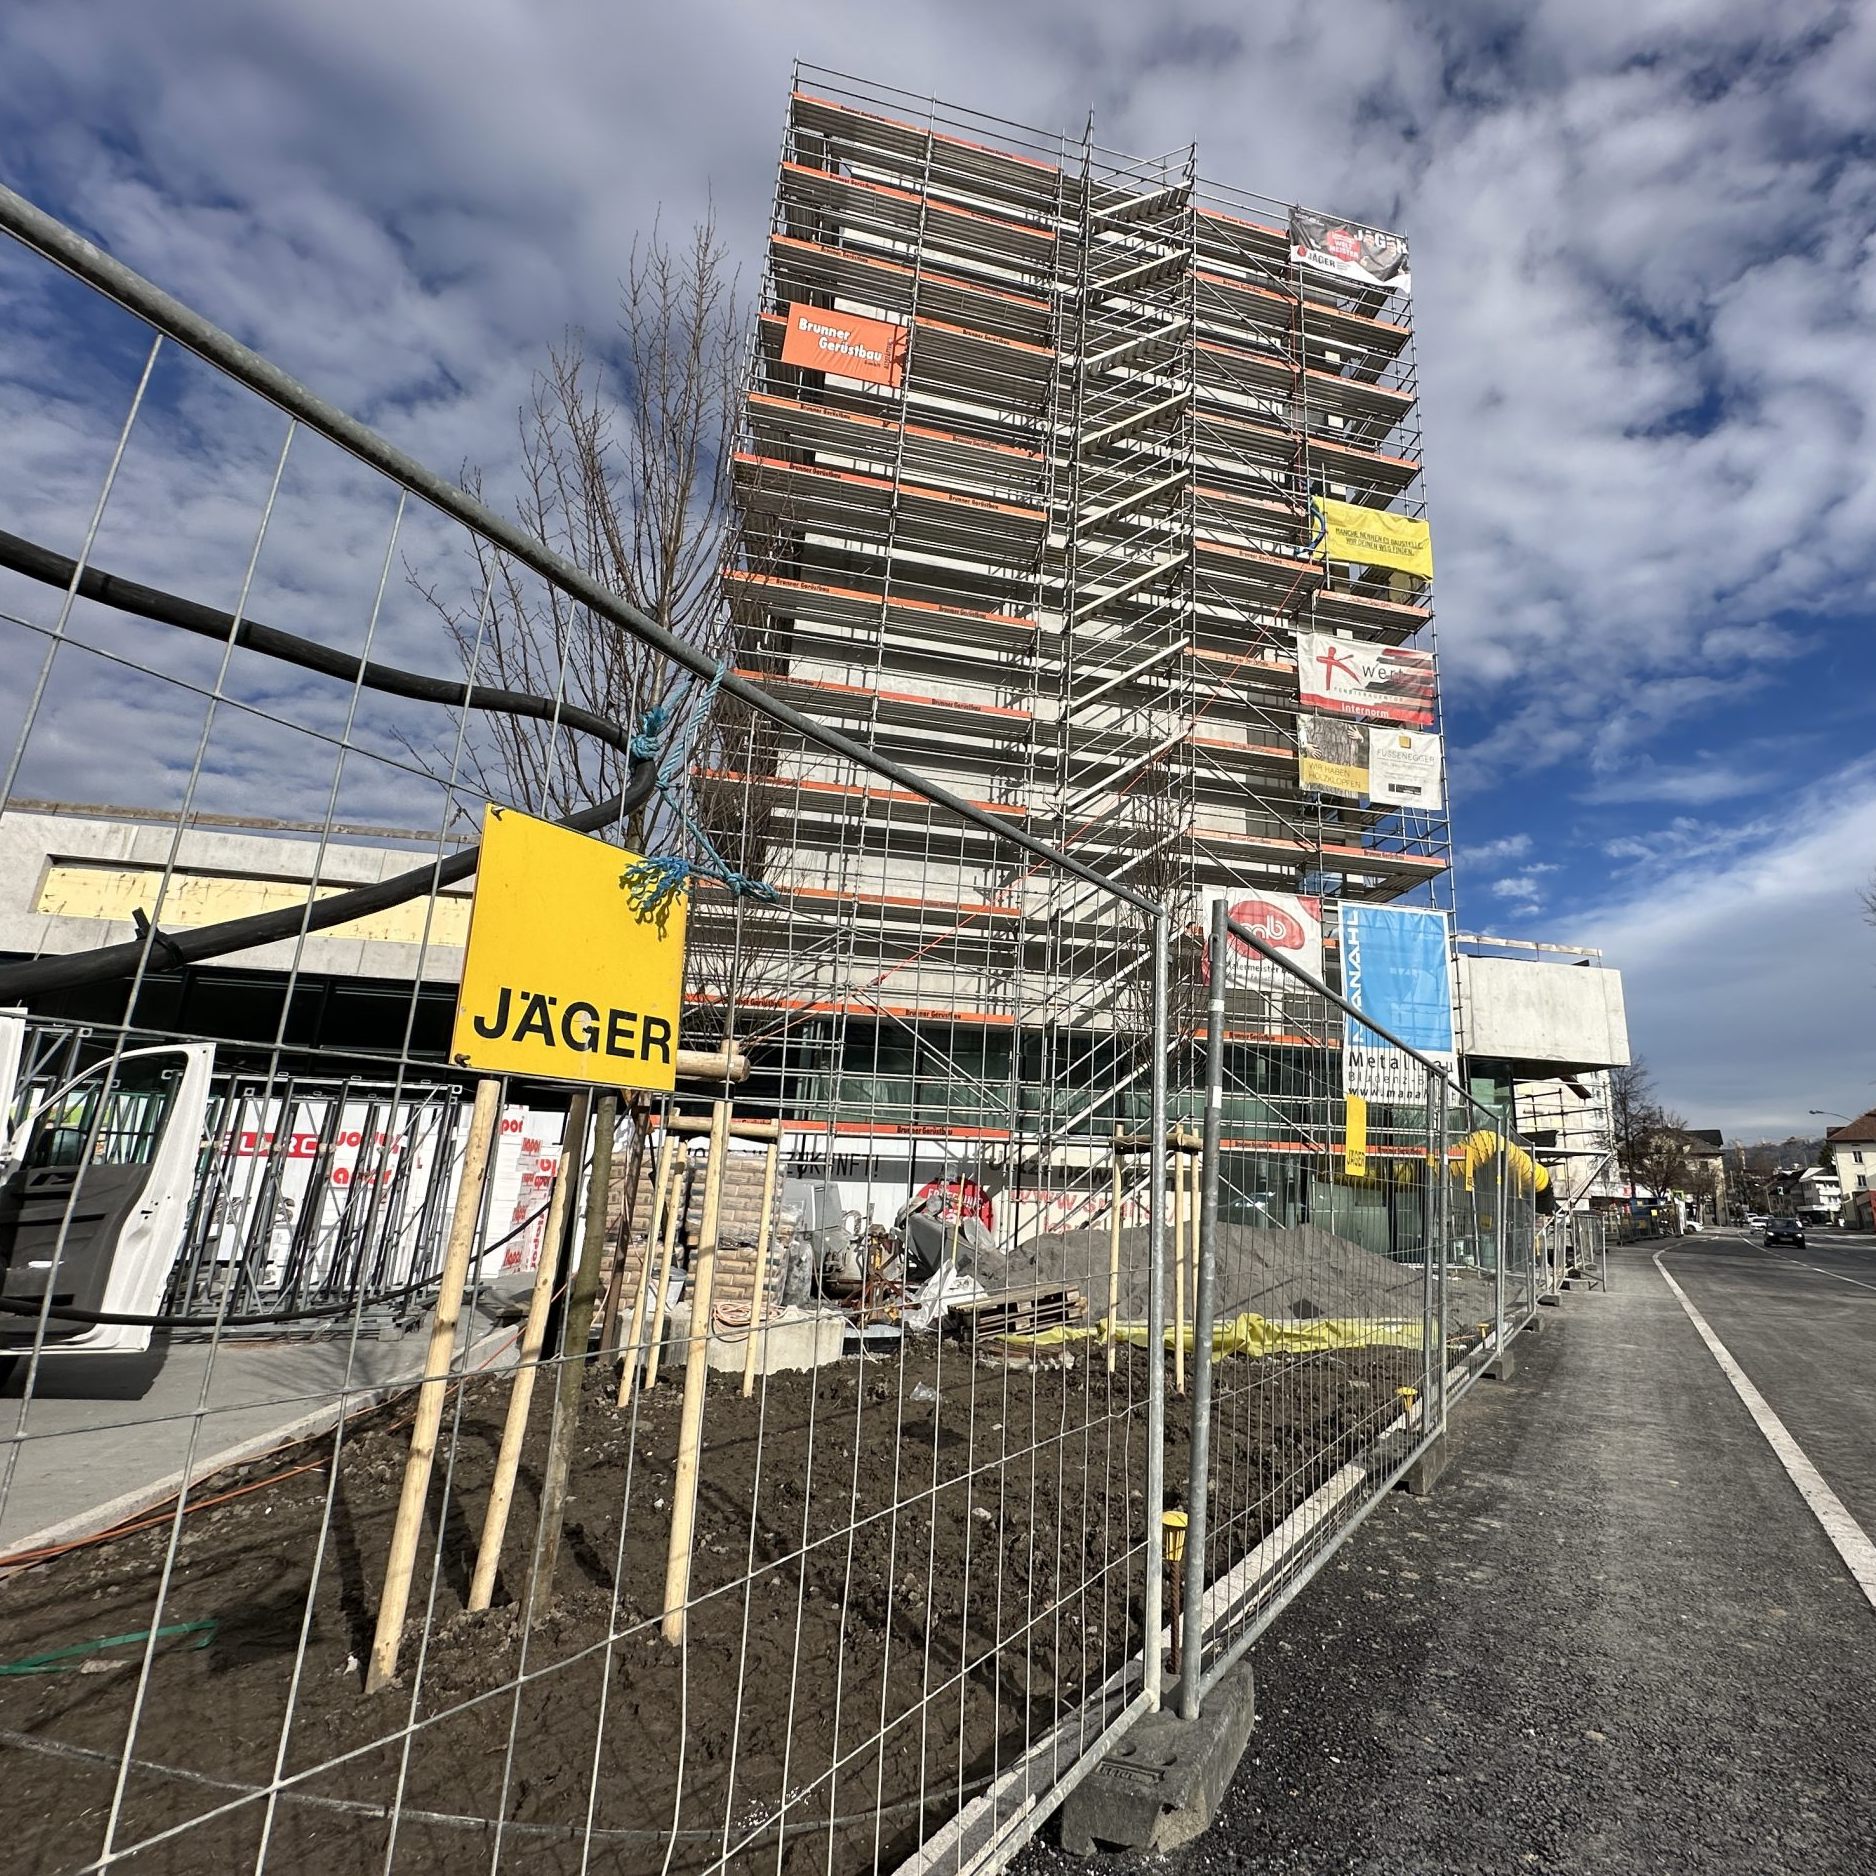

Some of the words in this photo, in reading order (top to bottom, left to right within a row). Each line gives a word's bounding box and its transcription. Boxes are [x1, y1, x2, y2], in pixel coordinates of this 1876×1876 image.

[1308, 252, 1336, 268] JÄGER
[798, 317, 851, 341] Brunner
[818, 336, 883, 361] Gerüstbau
[1341, 702, 1389, 719] Internorm
[1309, 762, 1323, 771] WIR
[1325, 765, 1351, 778] HABEN
[473, 986, 671, 1065] JÄGER
